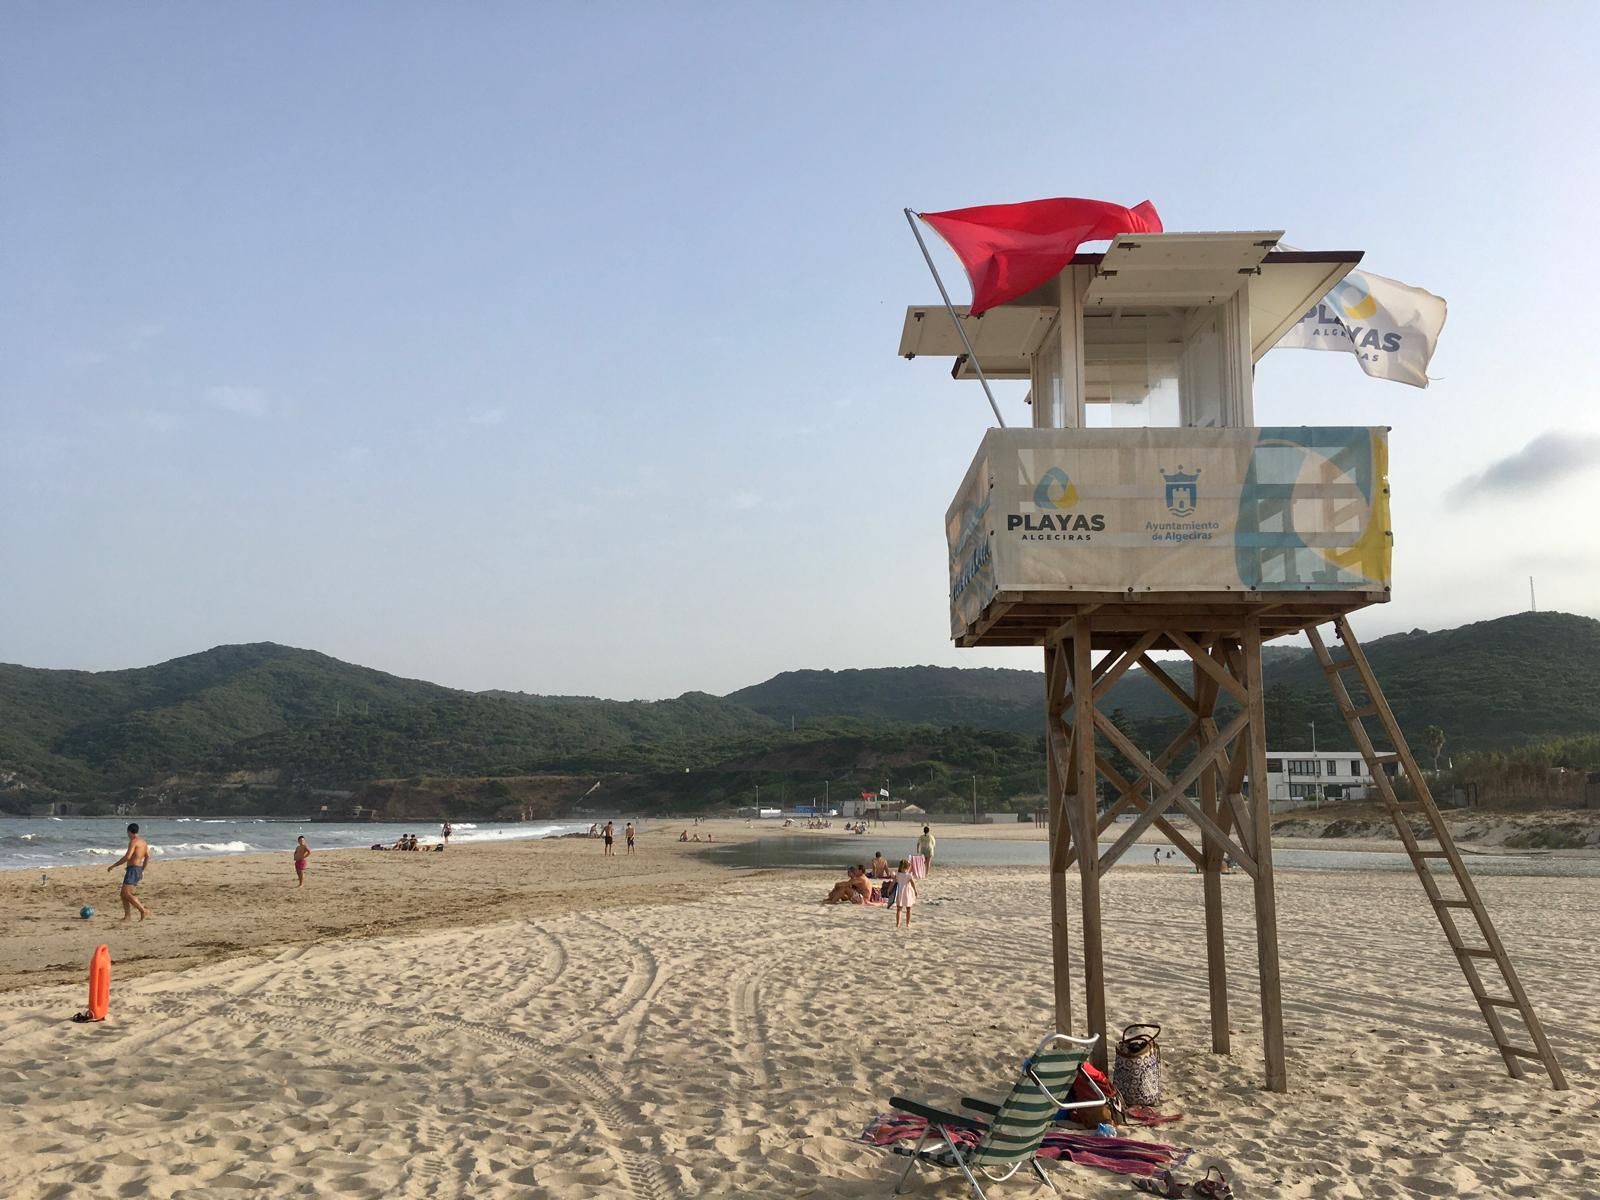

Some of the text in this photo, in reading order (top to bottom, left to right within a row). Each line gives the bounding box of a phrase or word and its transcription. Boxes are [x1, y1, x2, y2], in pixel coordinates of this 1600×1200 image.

[1007, 514, 1106, 532] PLAYAS
[1145, 521, 1219, 532] Ayuntamiento
[1152, 531, 1212, 543] de Algeciras
